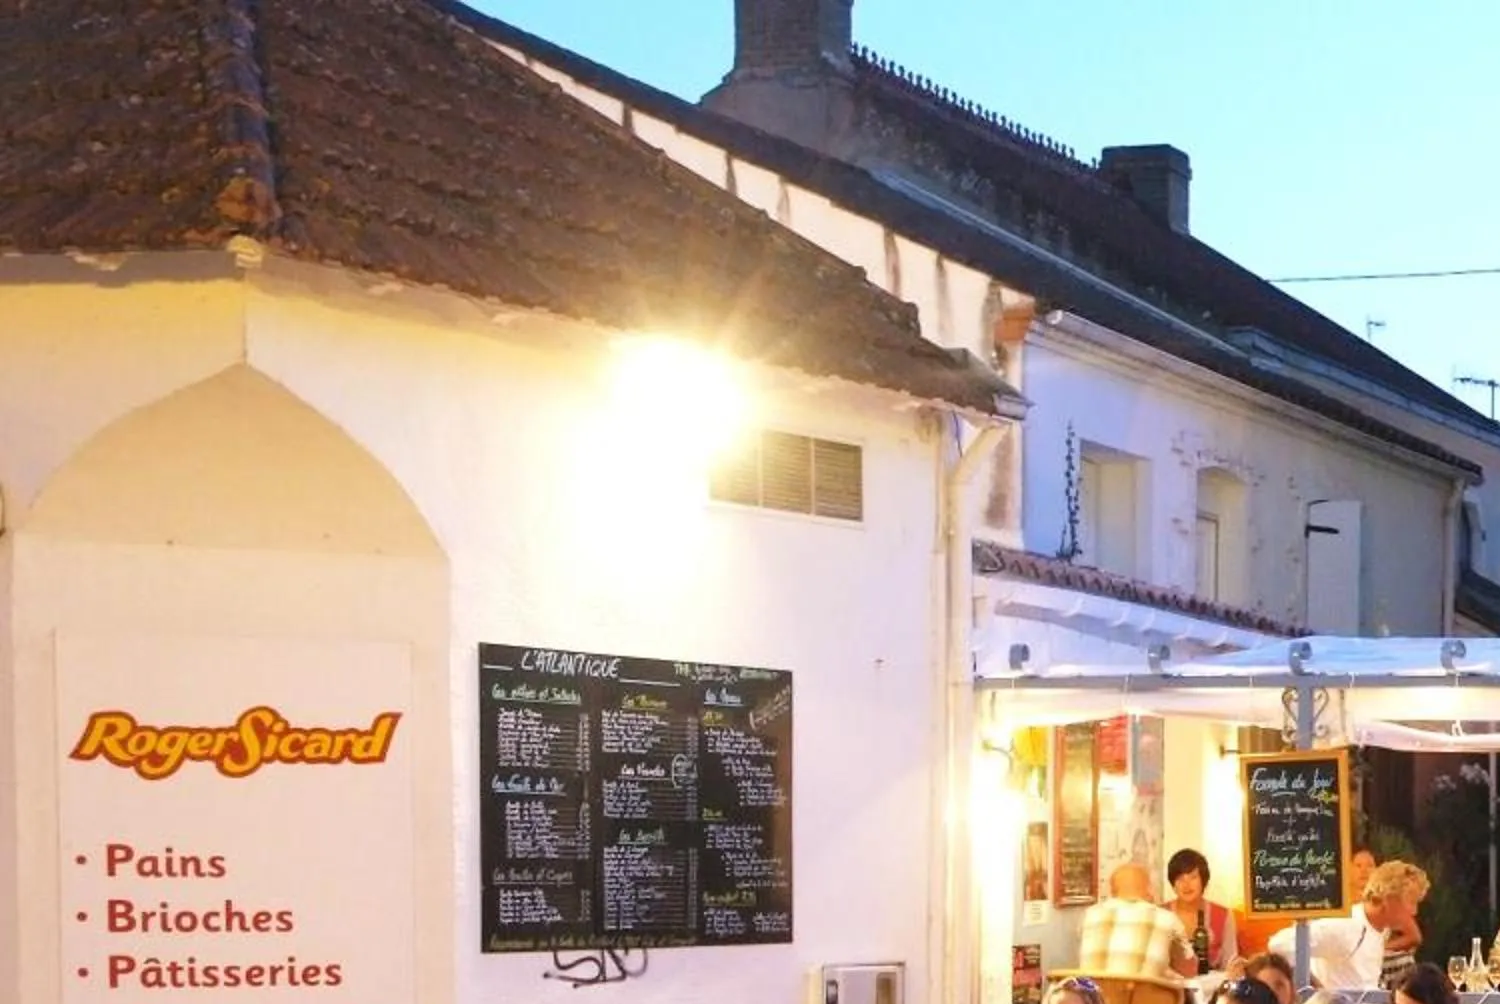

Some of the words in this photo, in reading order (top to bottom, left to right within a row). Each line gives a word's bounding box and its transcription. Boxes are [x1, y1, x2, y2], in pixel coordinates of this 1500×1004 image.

[106, 843, 227, 878] Pains
[107, 899, 294, 934] Brioches
[108, 955, 343, 989] Pâtisseries
